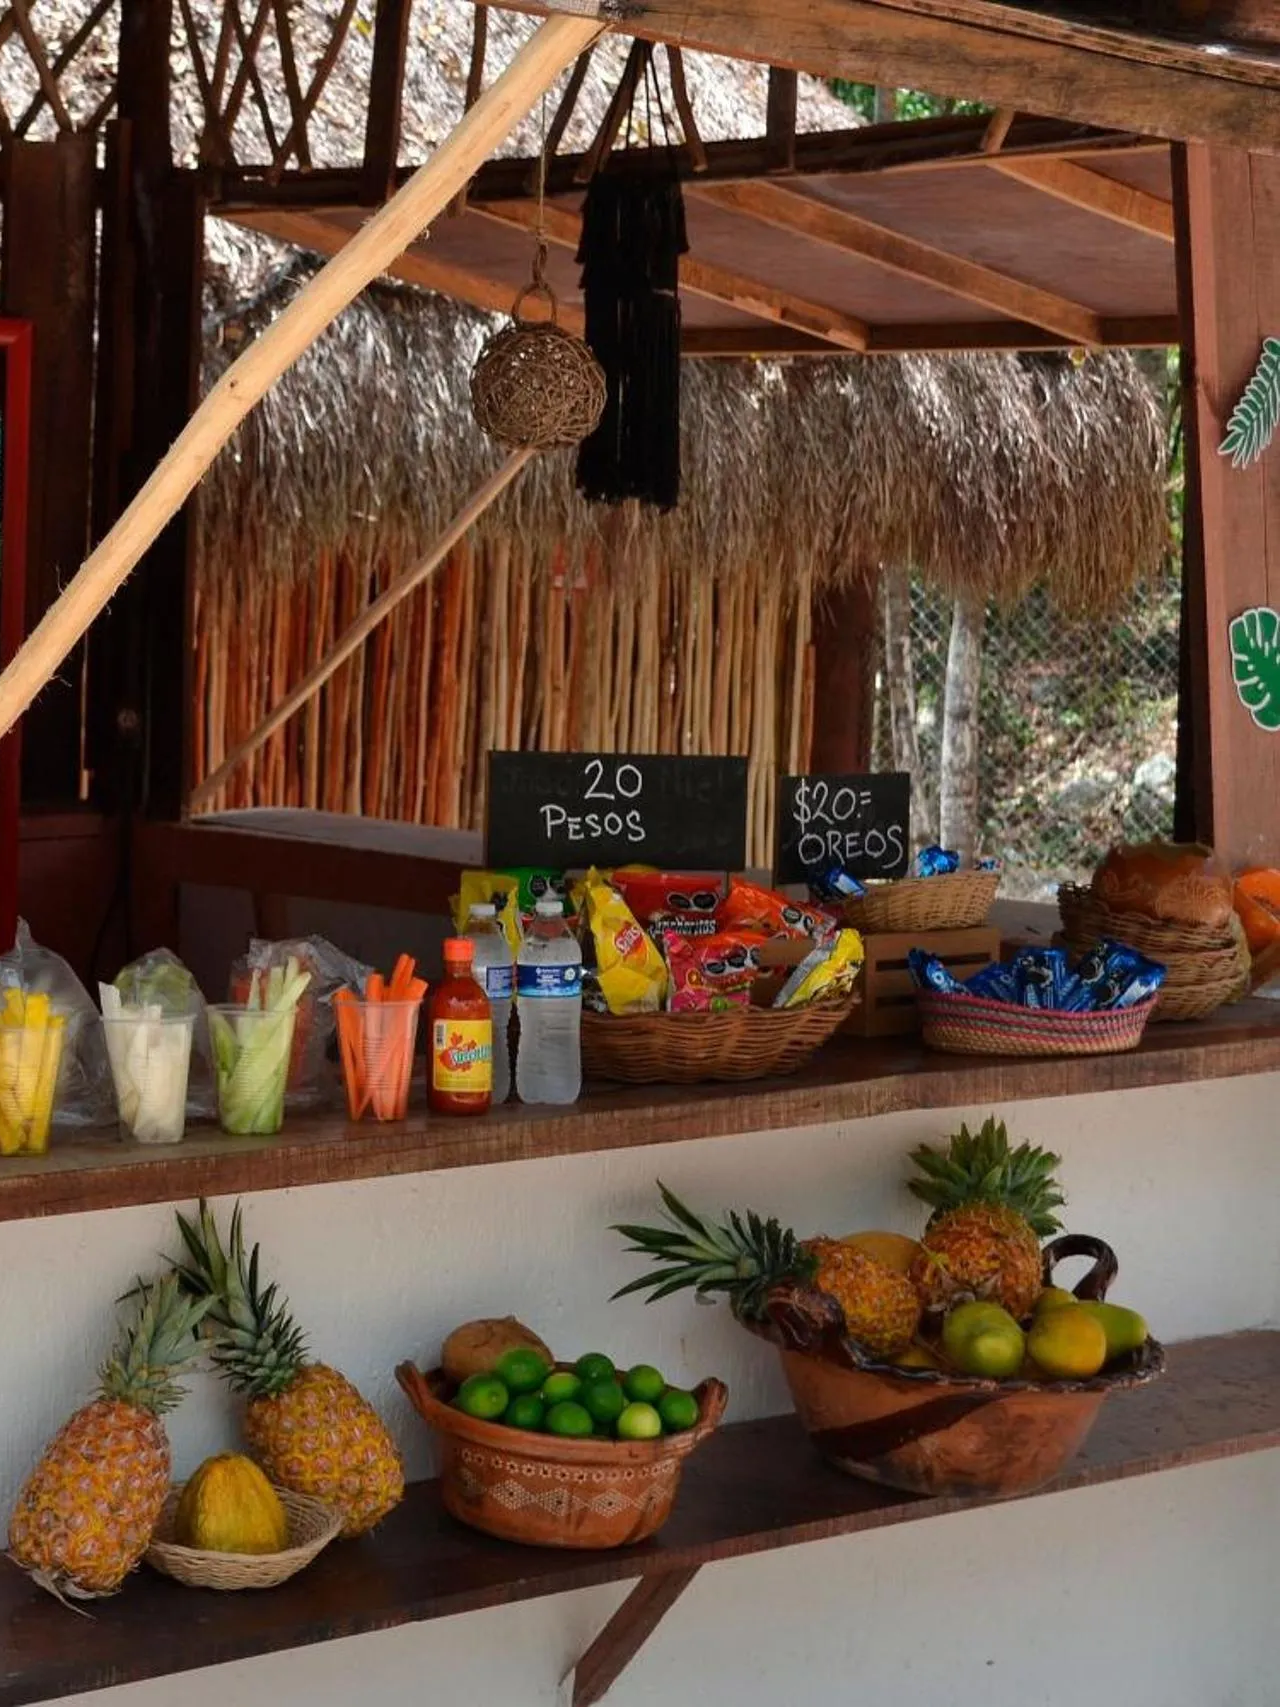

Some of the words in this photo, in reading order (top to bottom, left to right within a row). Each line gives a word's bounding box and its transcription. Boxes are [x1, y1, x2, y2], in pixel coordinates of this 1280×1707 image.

[583, 758, 643, 801] 20
[539, 803, 647, 842] PESOS
[798, 824, 903, 869] OREOS
